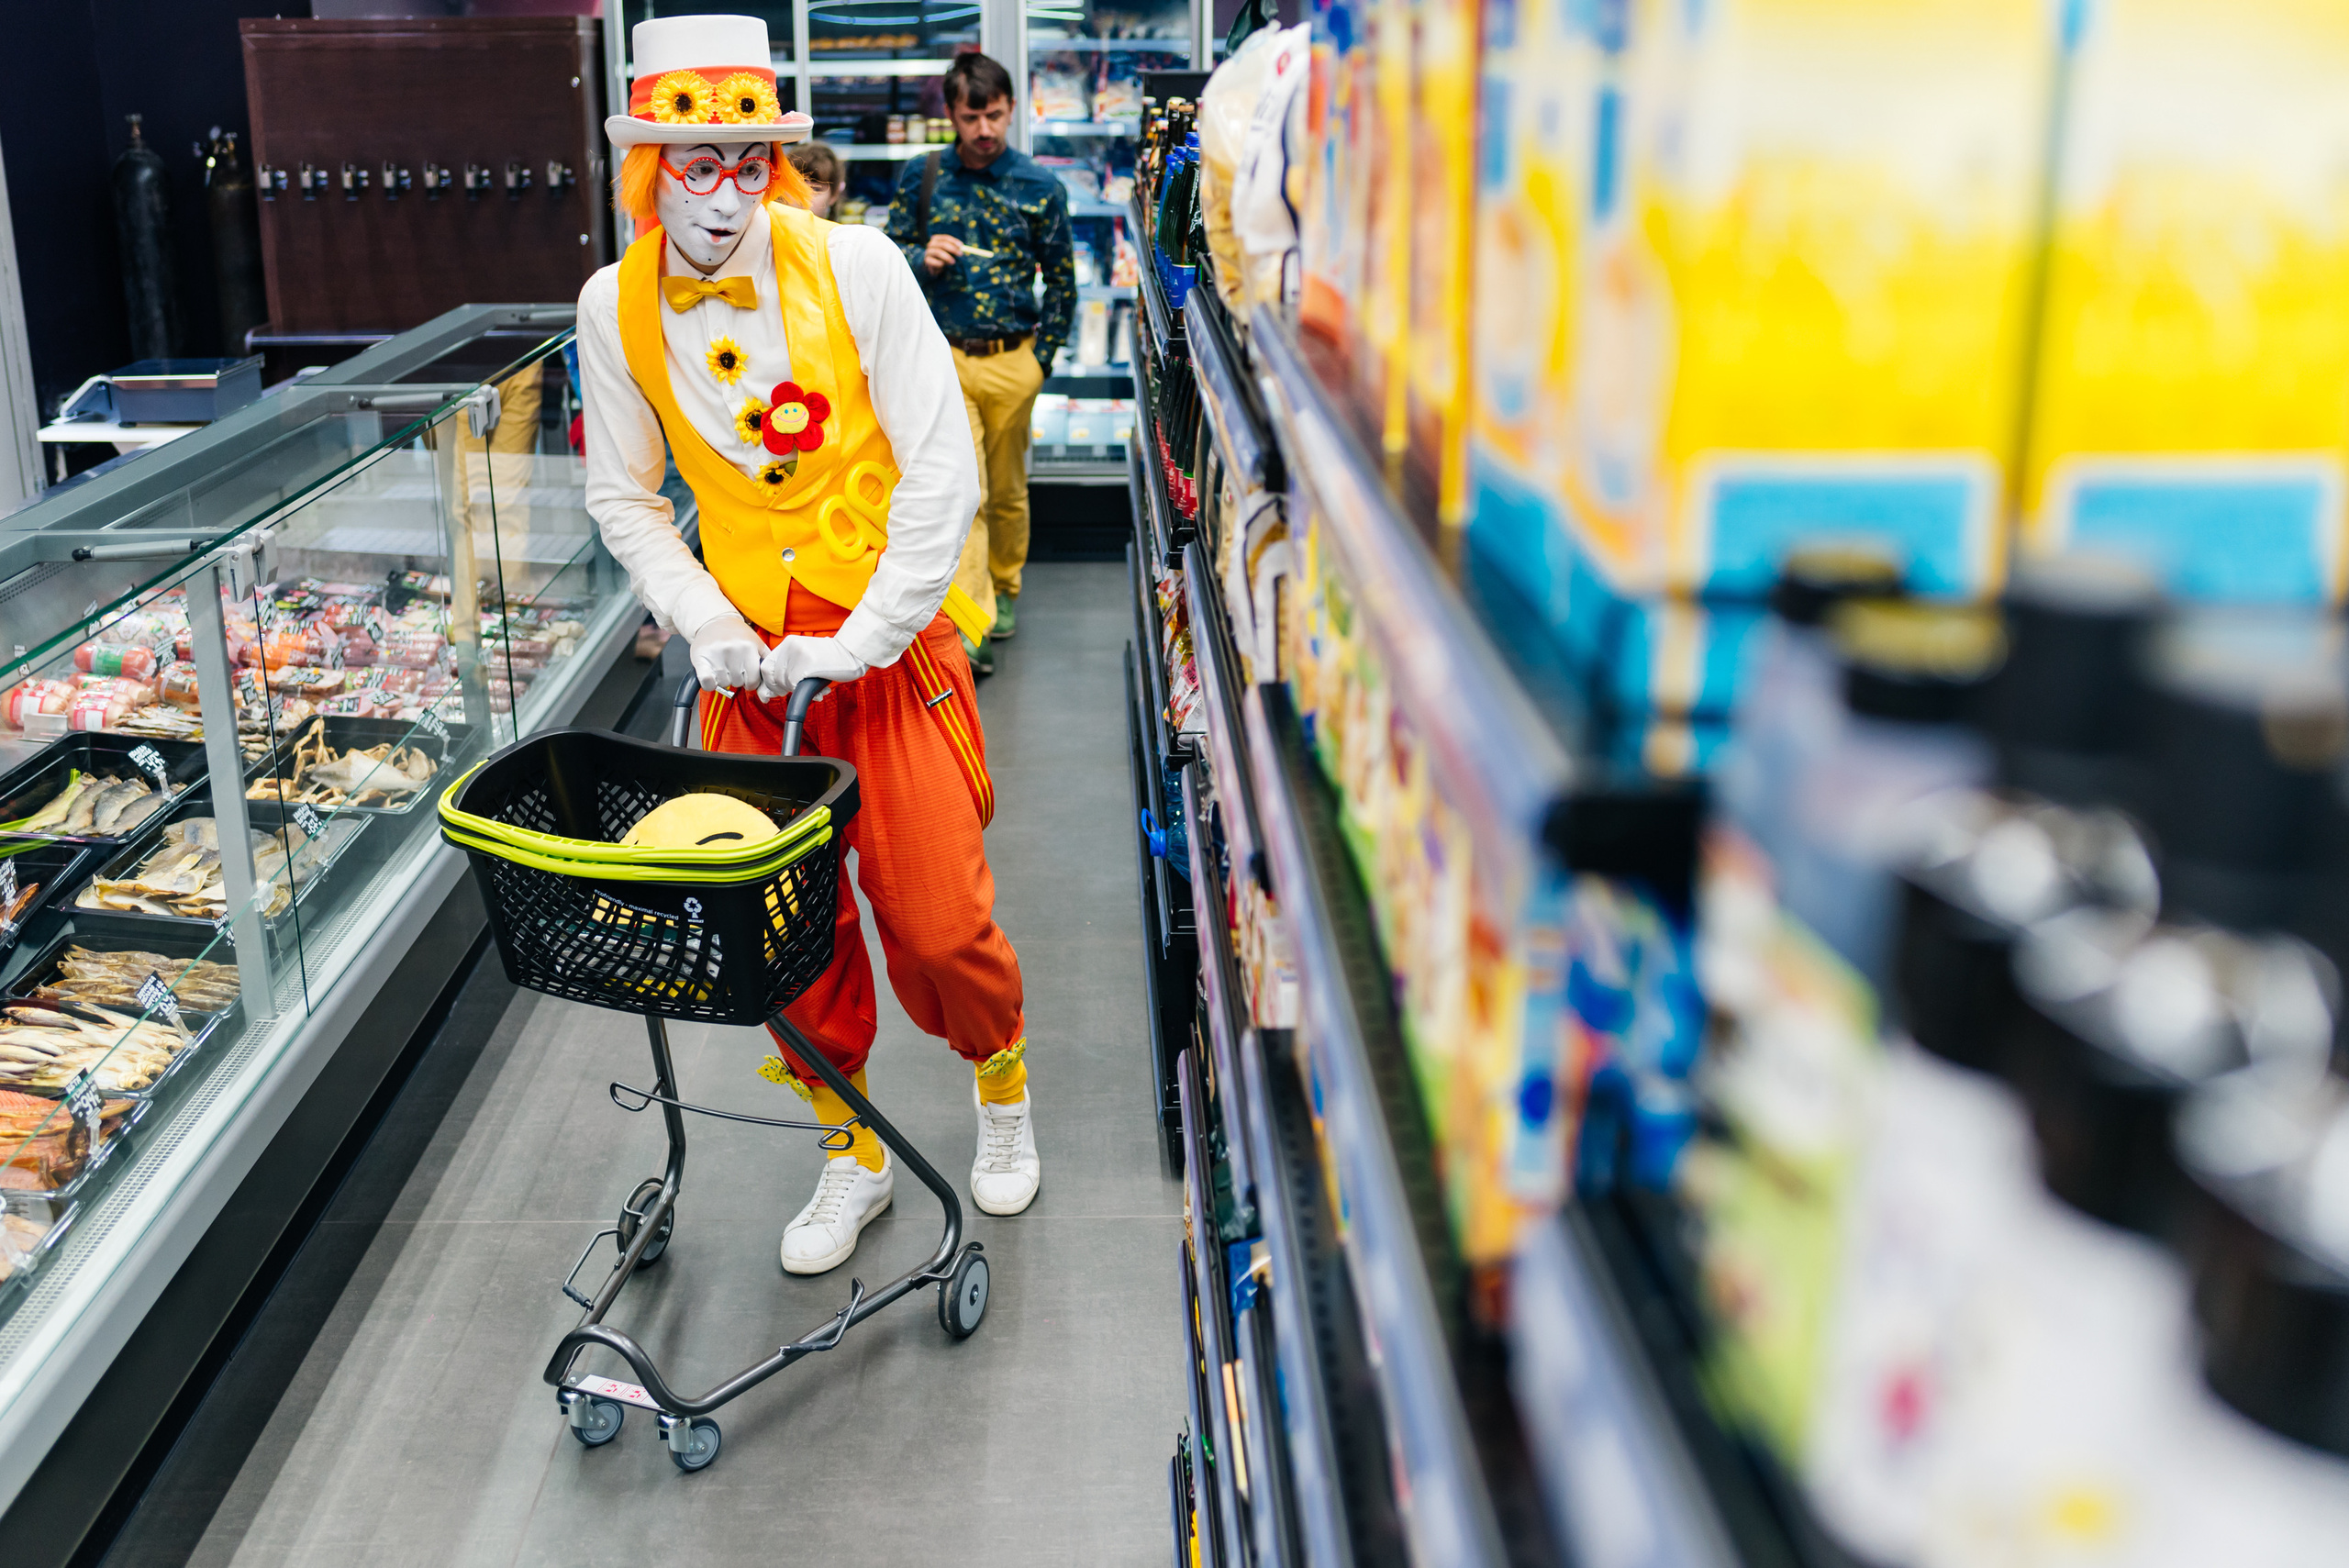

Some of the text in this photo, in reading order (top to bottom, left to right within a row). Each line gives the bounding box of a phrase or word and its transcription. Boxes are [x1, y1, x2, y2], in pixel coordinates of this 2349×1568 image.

[594, 888, 625, 906] ecofriendly
[629, 904, 653, 915] maximal
[654, 910, 679, 920] recycled
